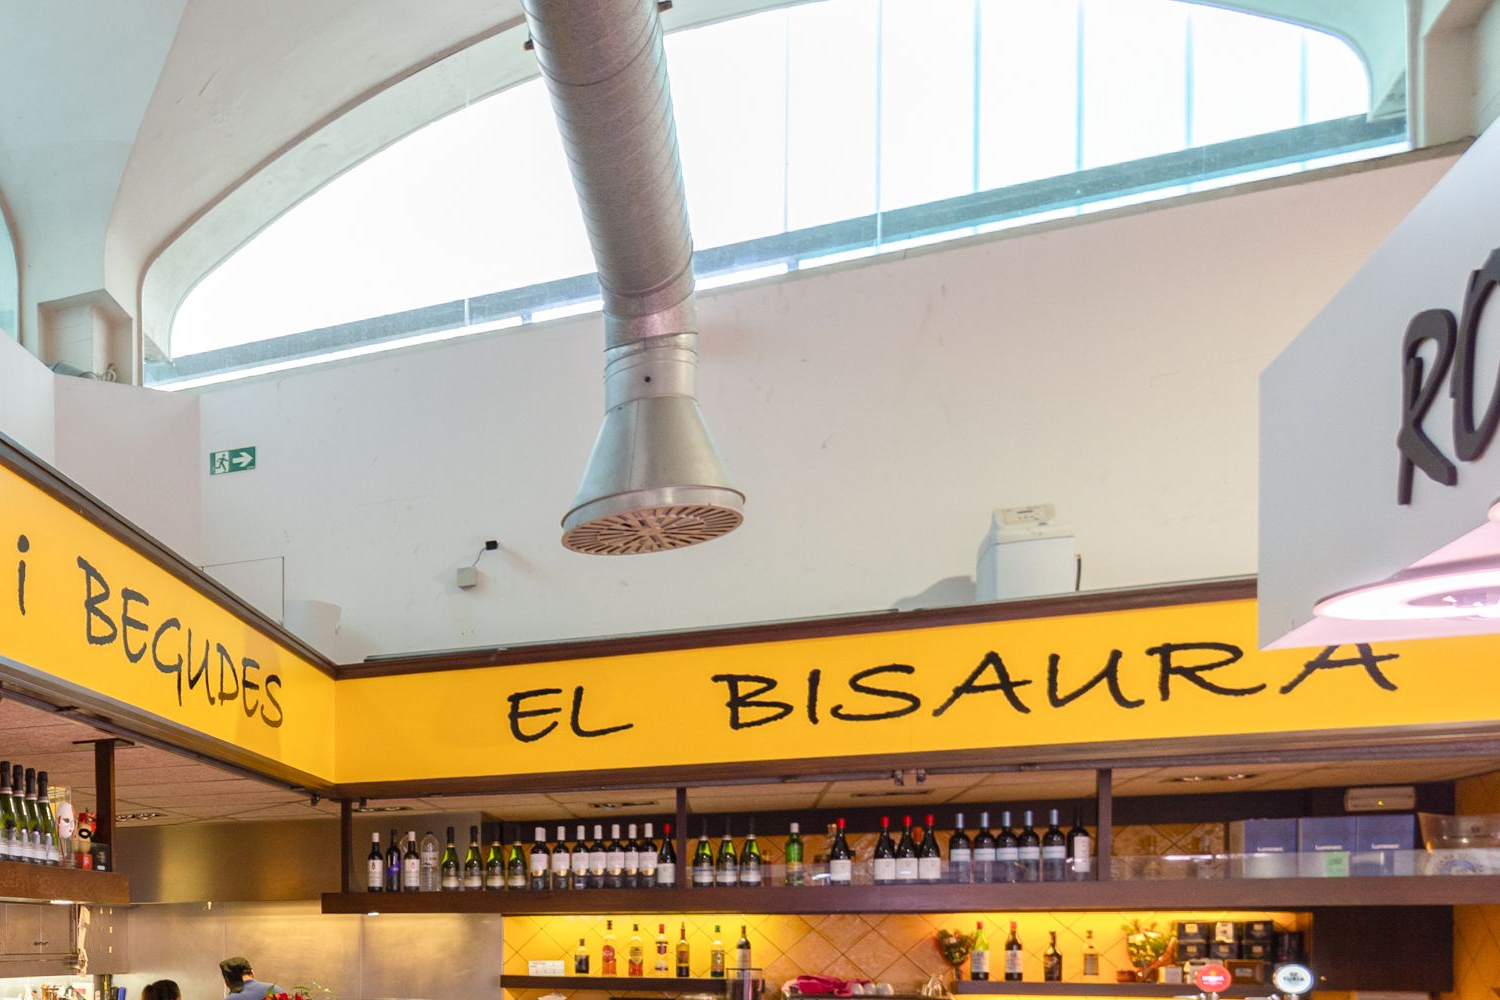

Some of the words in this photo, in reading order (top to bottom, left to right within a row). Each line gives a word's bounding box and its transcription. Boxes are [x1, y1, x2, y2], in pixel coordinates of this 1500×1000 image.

[17, 534, 30, 616] i
[76, 555, 284, 728] BEGUDES
[505, 685, 633, 742] EL
[711, 641, 1400, 730] BISAURA
